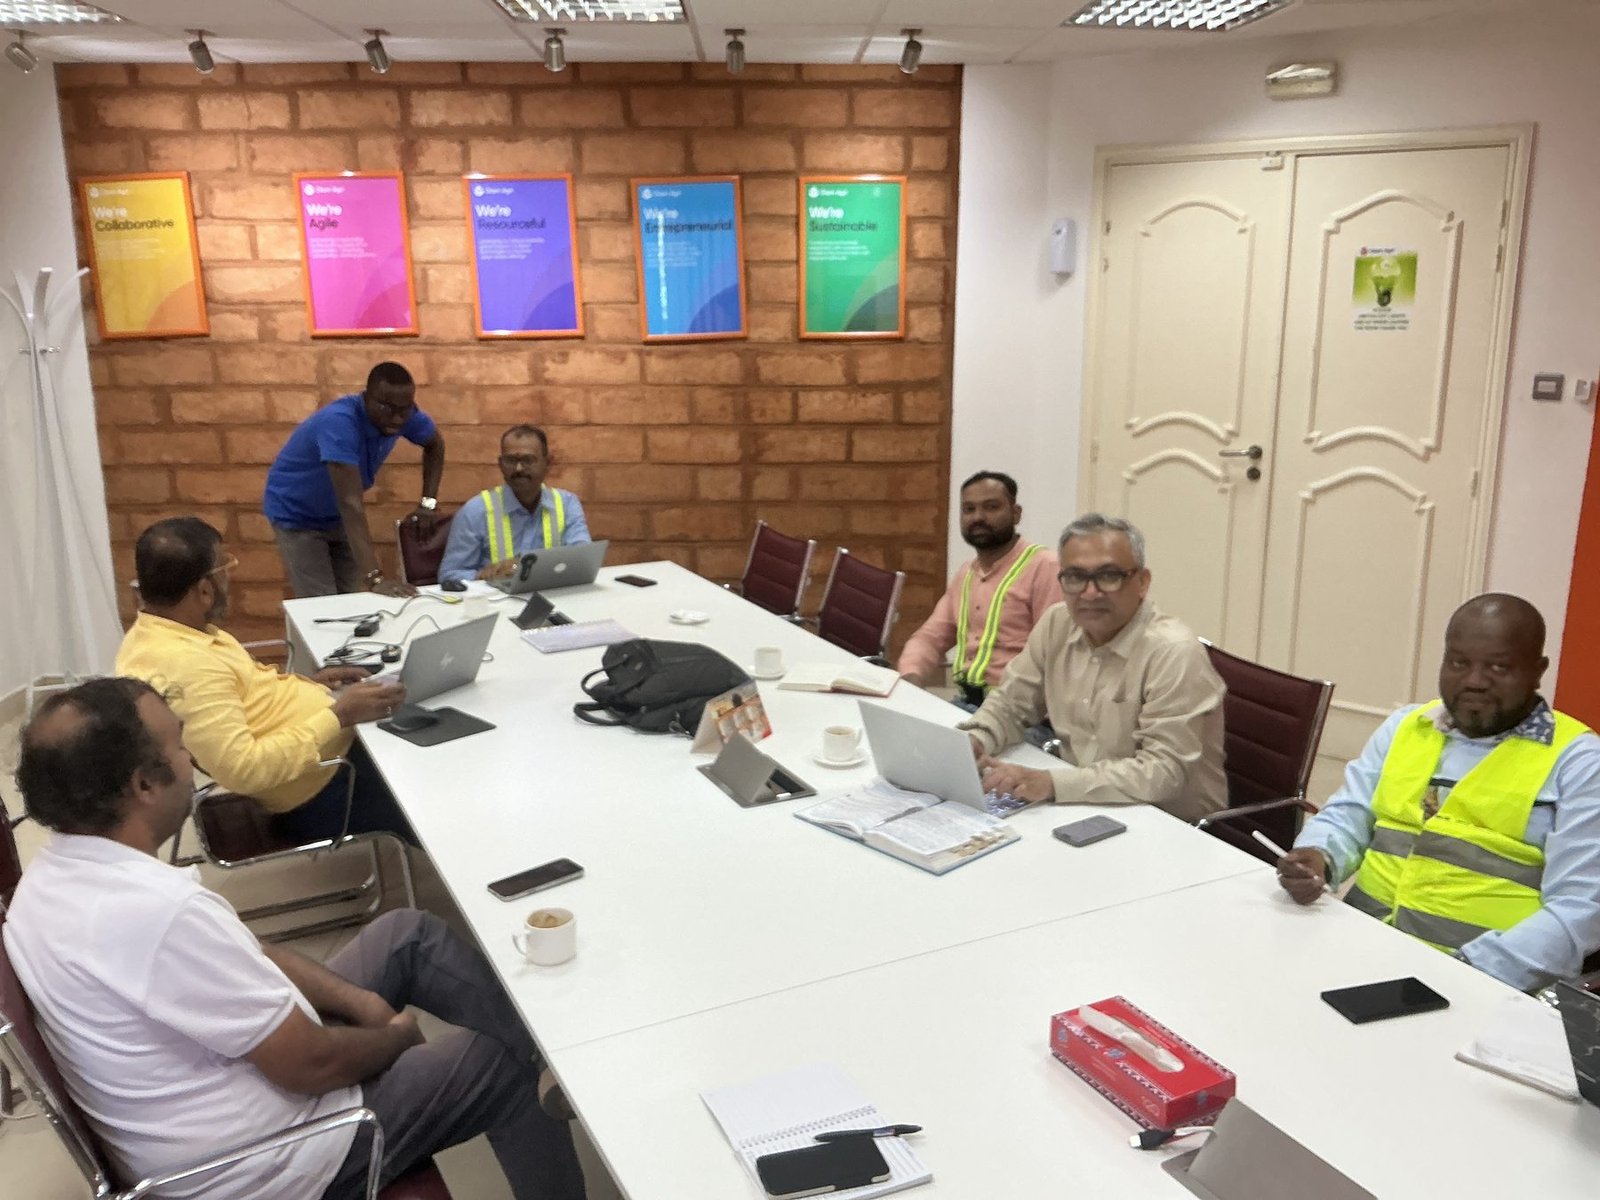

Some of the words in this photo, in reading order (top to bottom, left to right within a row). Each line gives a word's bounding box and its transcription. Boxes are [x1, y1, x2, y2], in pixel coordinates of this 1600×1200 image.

[306, 203, 343, 216] We're
[475, 204, 512, 217] We're
[642, 207, 679, 219] W're
[808, 206, 845, 219] We're
[94, 219, 174, 232] Collaborative
[309, 217, 339, 231] Agile
[478, 217, 547, 231] Resourceful
[808, 219, 878, 233] Sustainable
